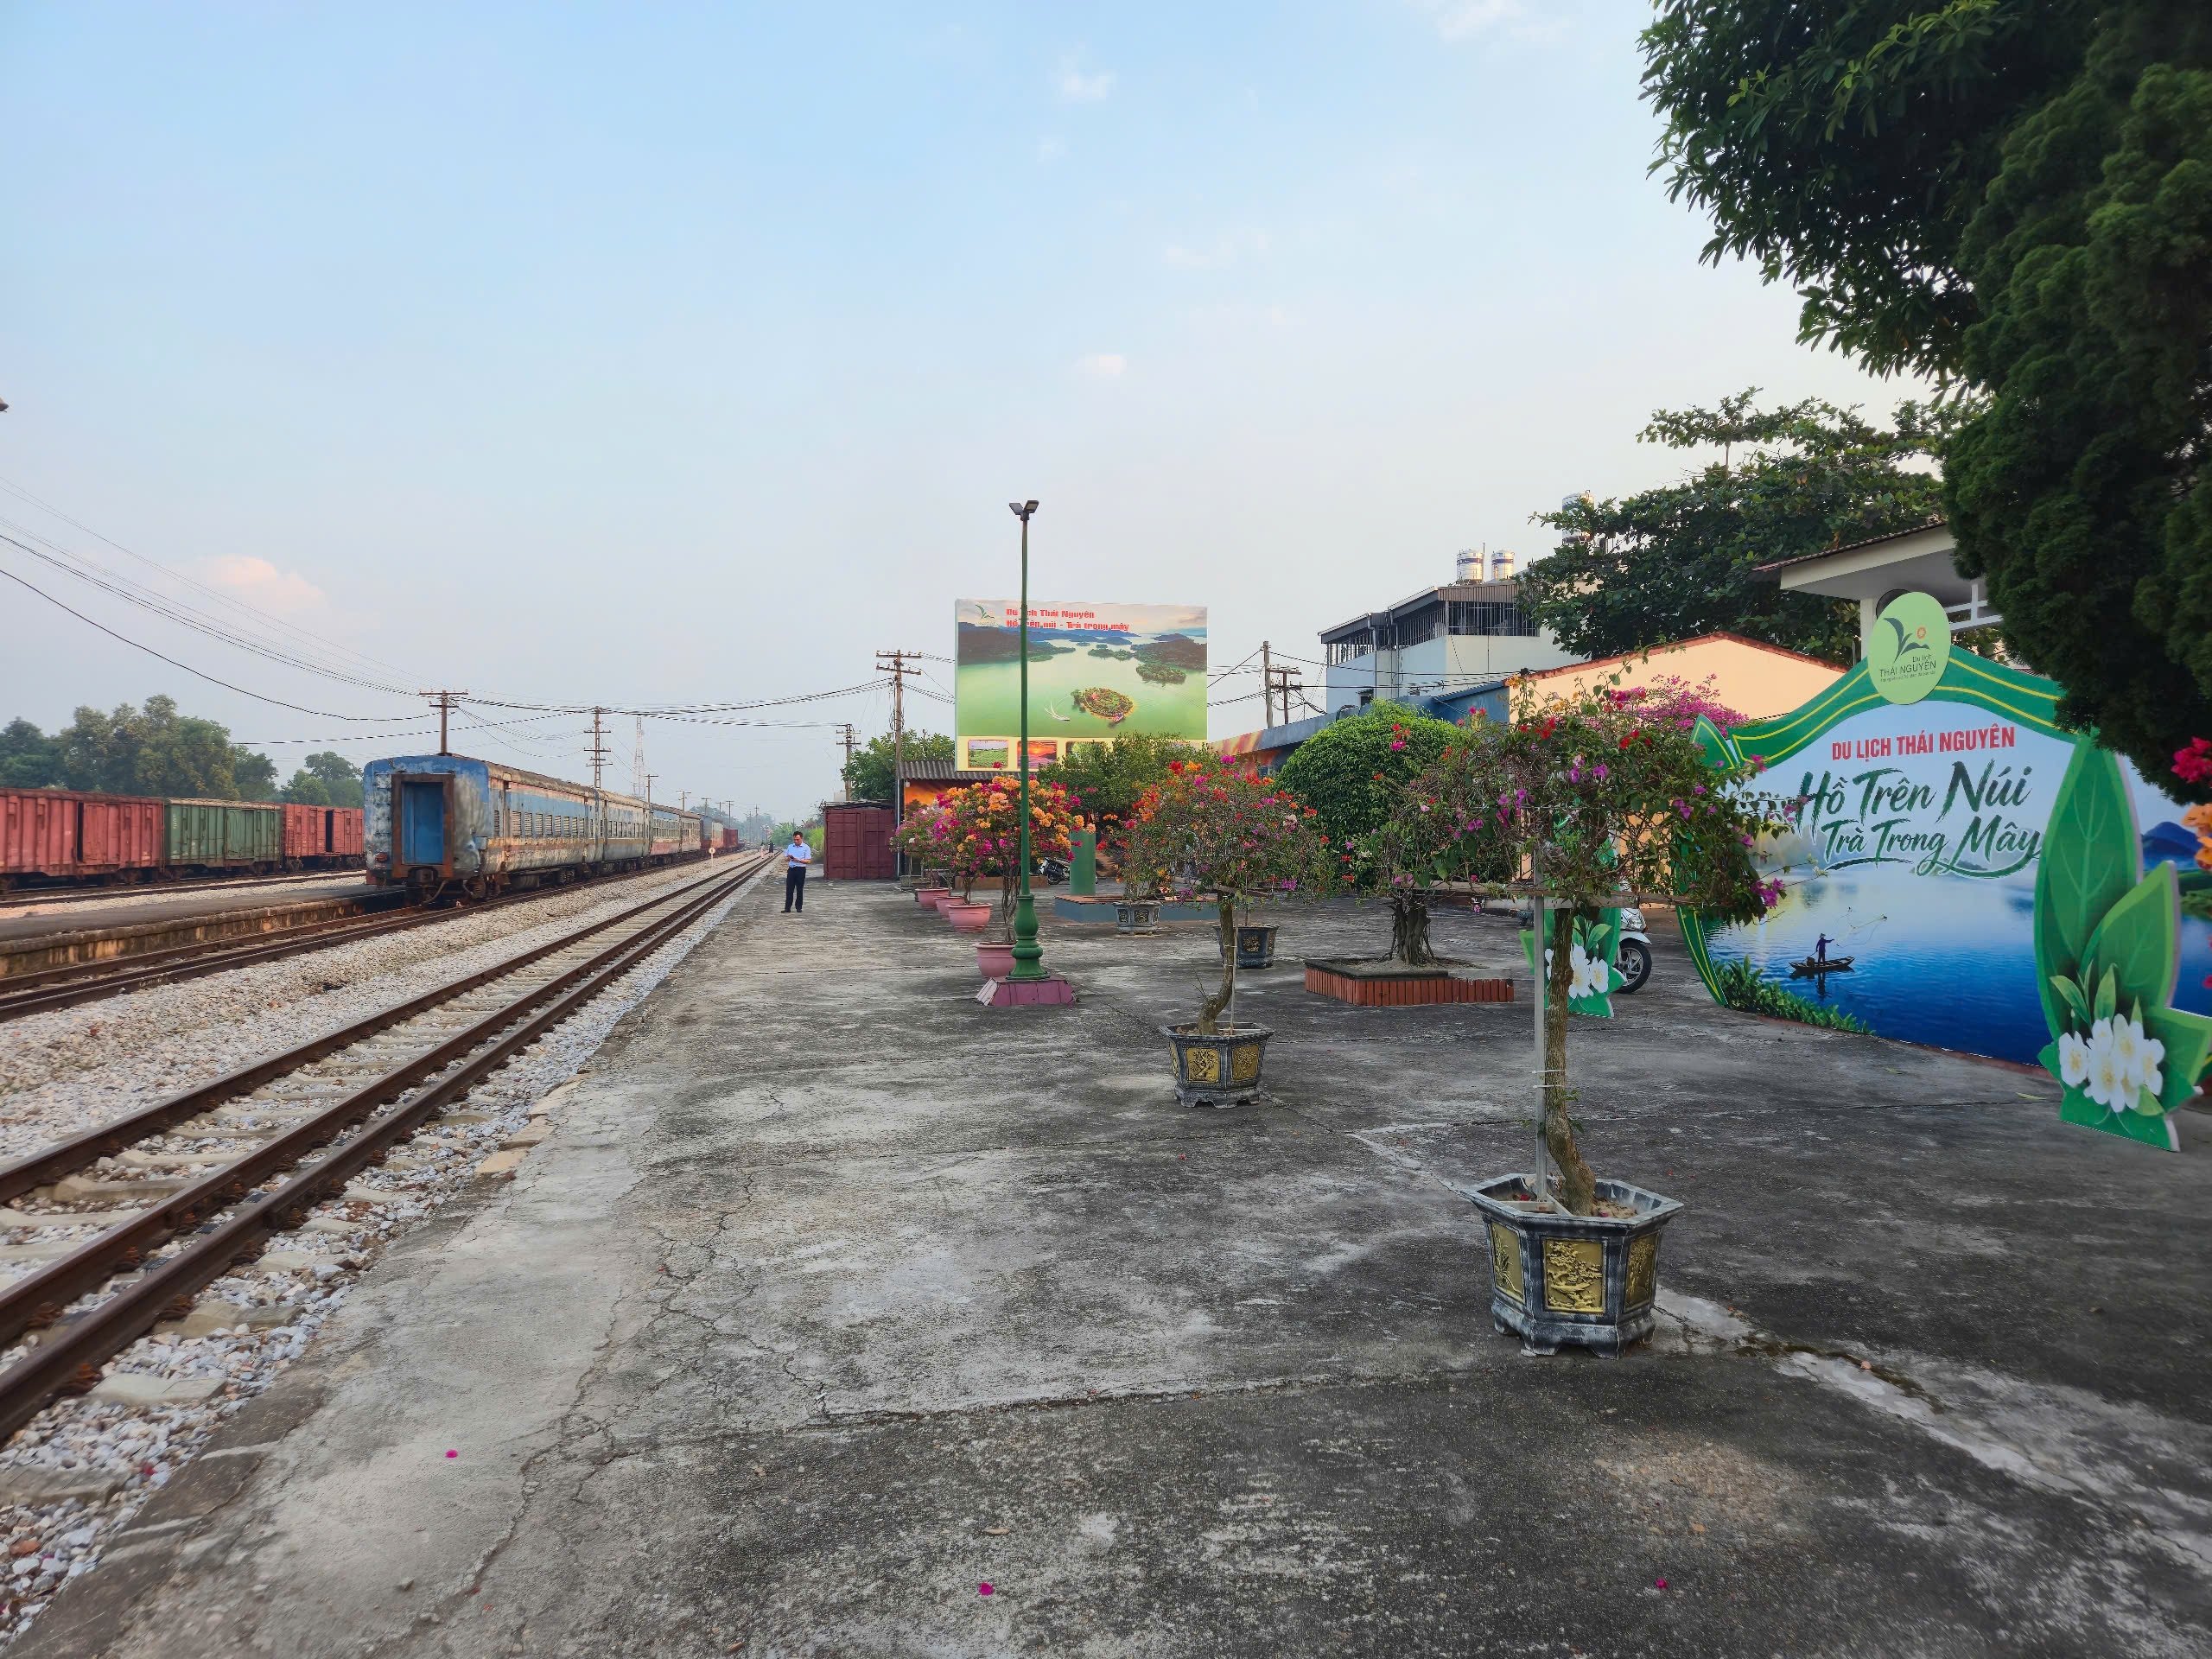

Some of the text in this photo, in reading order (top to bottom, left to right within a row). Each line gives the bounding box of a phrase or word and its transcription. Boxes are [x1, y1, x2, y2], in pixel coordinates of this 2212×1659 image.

[1061, 610, 1096, 620] Nguyên
[1084, 622, 1109, 631] trong
[1832, 722, 2016, 762] DU LỊCH THÁI NGUYÊN
[1796, 757, 2032, 844] Hồ Trên Núi
[1821, 814, 2041, 879] Trà Trong Mây
